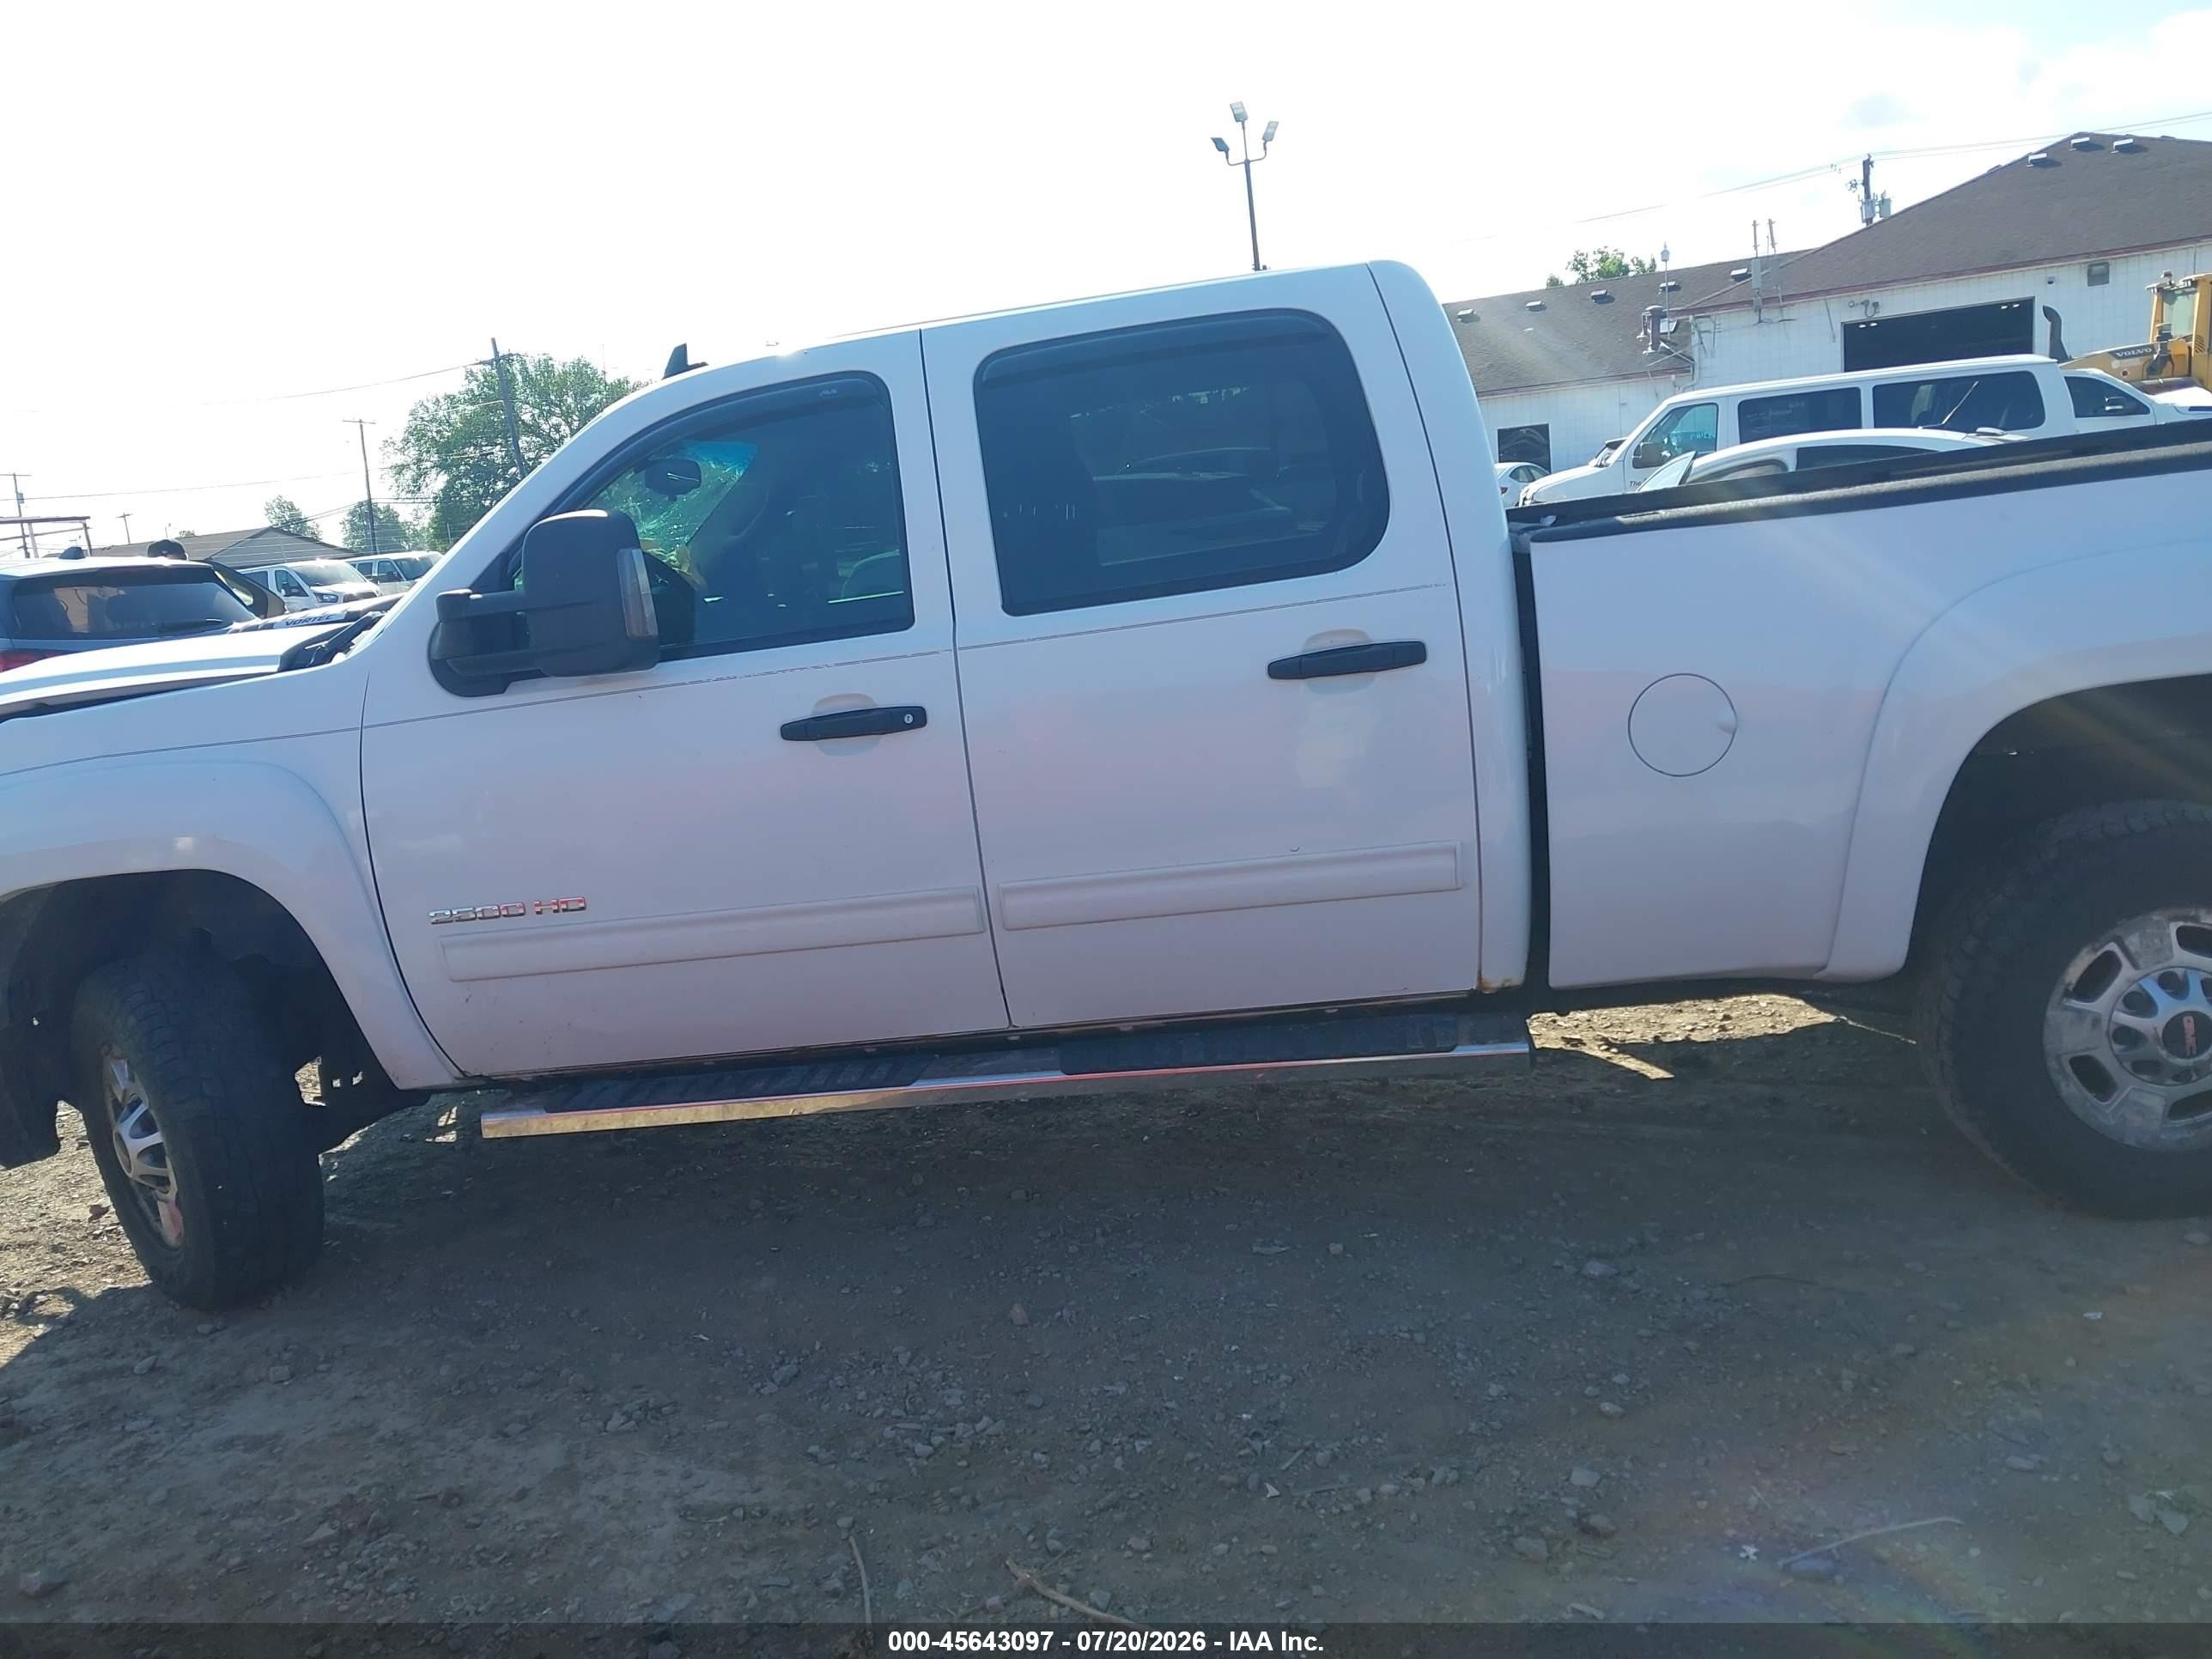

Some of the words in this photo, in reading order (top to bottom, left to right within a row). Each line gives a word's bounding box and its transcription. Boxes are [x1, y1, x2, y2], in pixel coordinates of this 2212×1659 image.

[2116, 348, 2152, 356] VOLVO
[285, 614, 332, 626] VORTEC
[428, 902, 526, 925] 2500
[533, 896, 586, 915] HD
